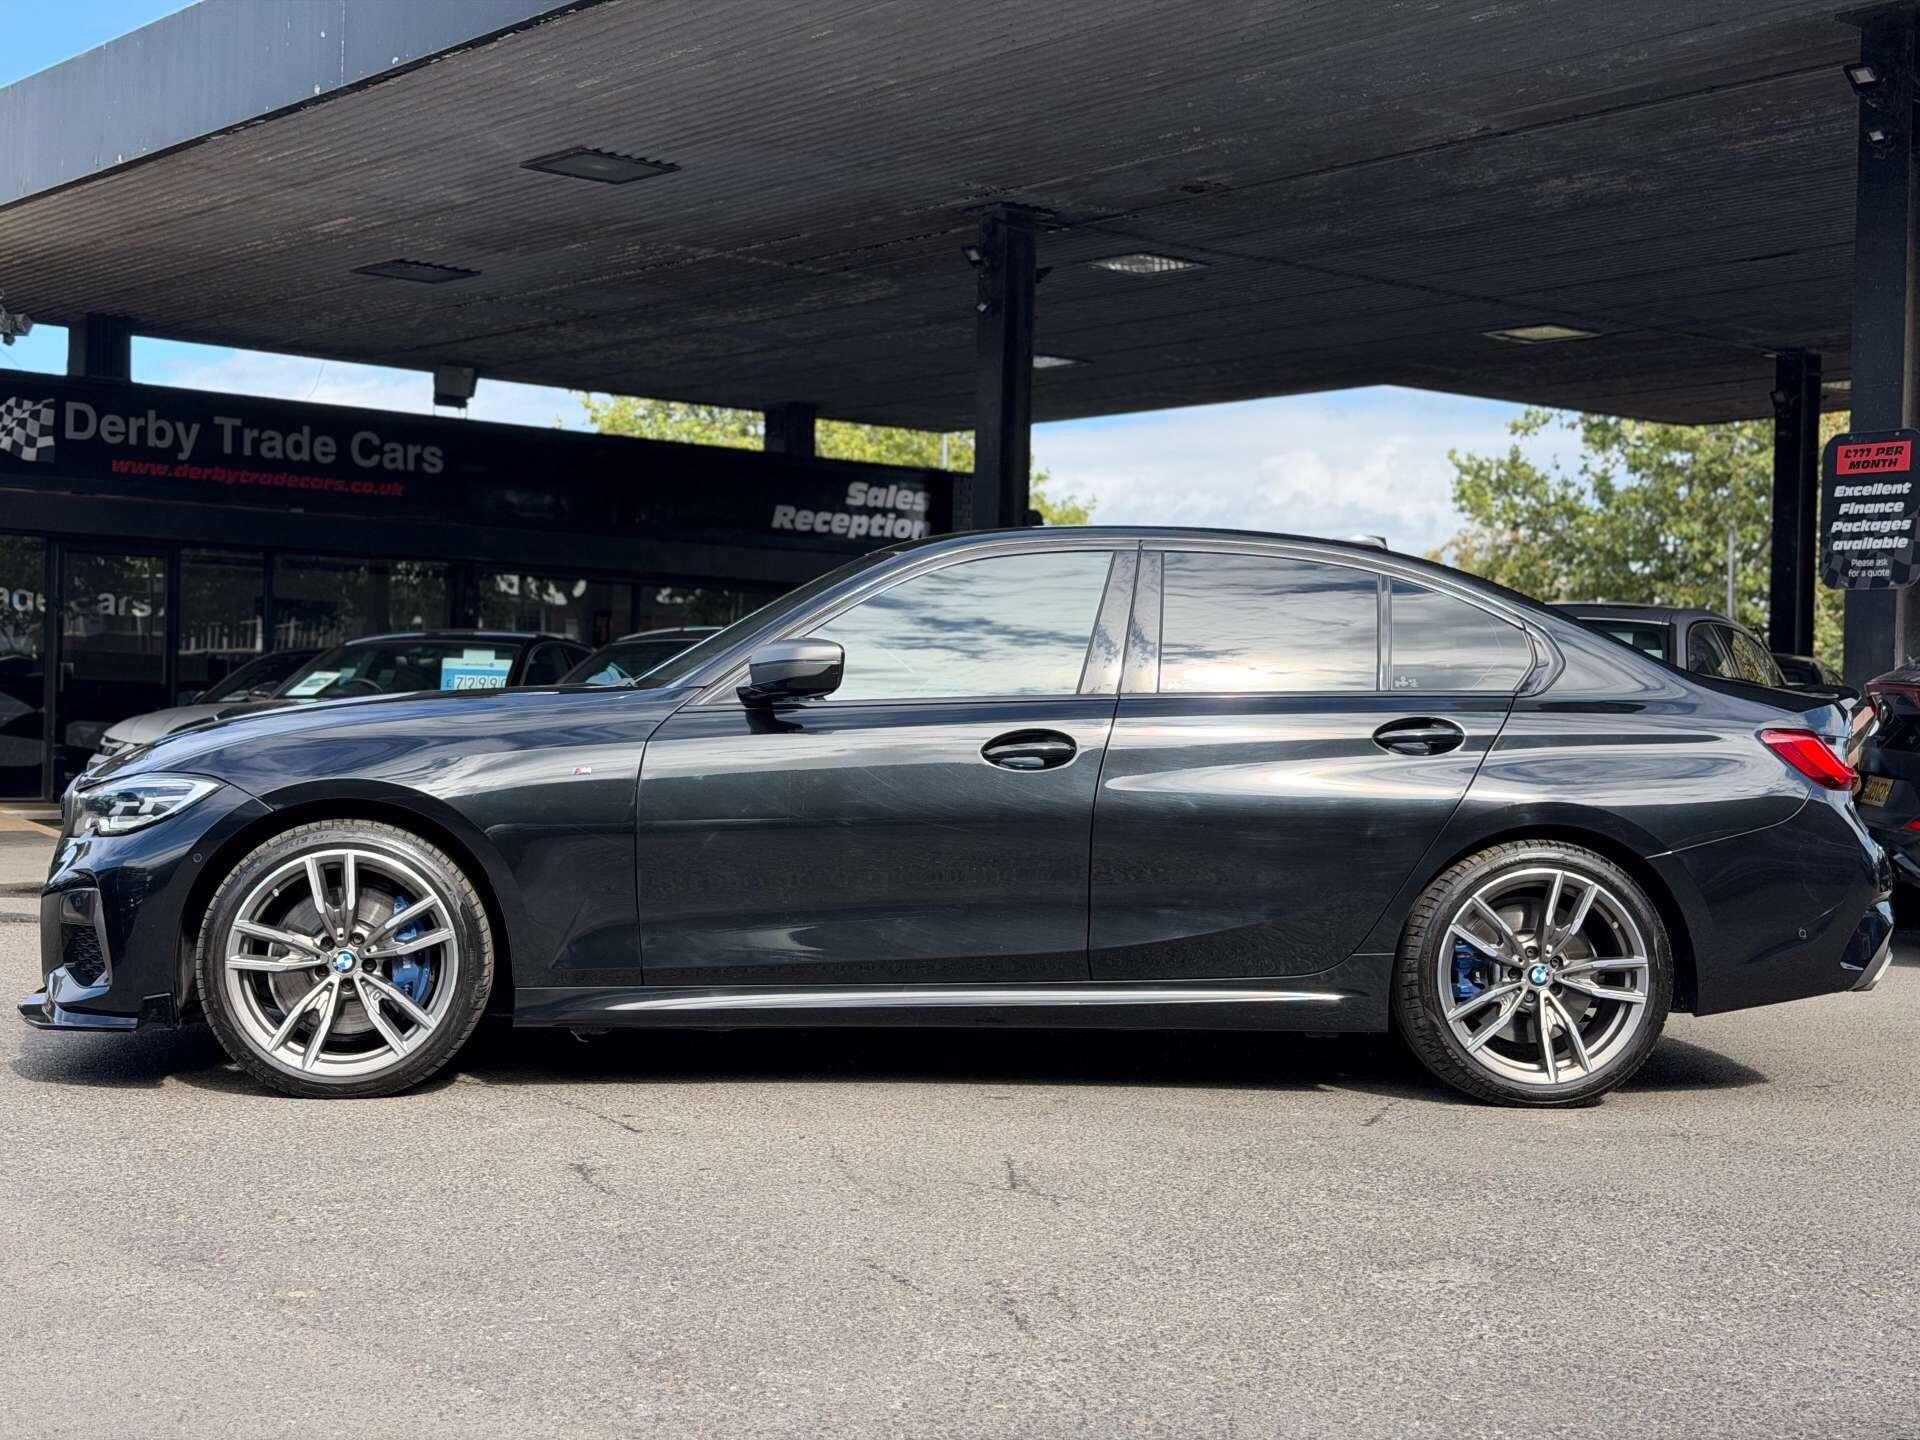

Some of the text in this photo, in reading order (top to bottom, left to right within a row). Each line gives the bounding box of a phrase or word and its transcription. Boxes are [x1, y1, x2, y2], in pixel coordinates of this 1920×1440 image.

[65, 402, 444, 475] Derby Trade Cars
[1875, 446, 1904, 456] PER
[1848, 458, 1898, 470] MONTH
[1834, 482, 1912, 497] Excellent
[846, 482, 931, 512] Sales
[1839, 502, 1904, 515] Finance
[771, 504, 931, 539] Reception
[1831, 519, 1912, 533] Packages
[1832, 536, 1908, 551] available
[1851, 559, 1875, 567] Please
[1848, 569, 1860, 577] for
[1867, 567, 1890, 578] quote
